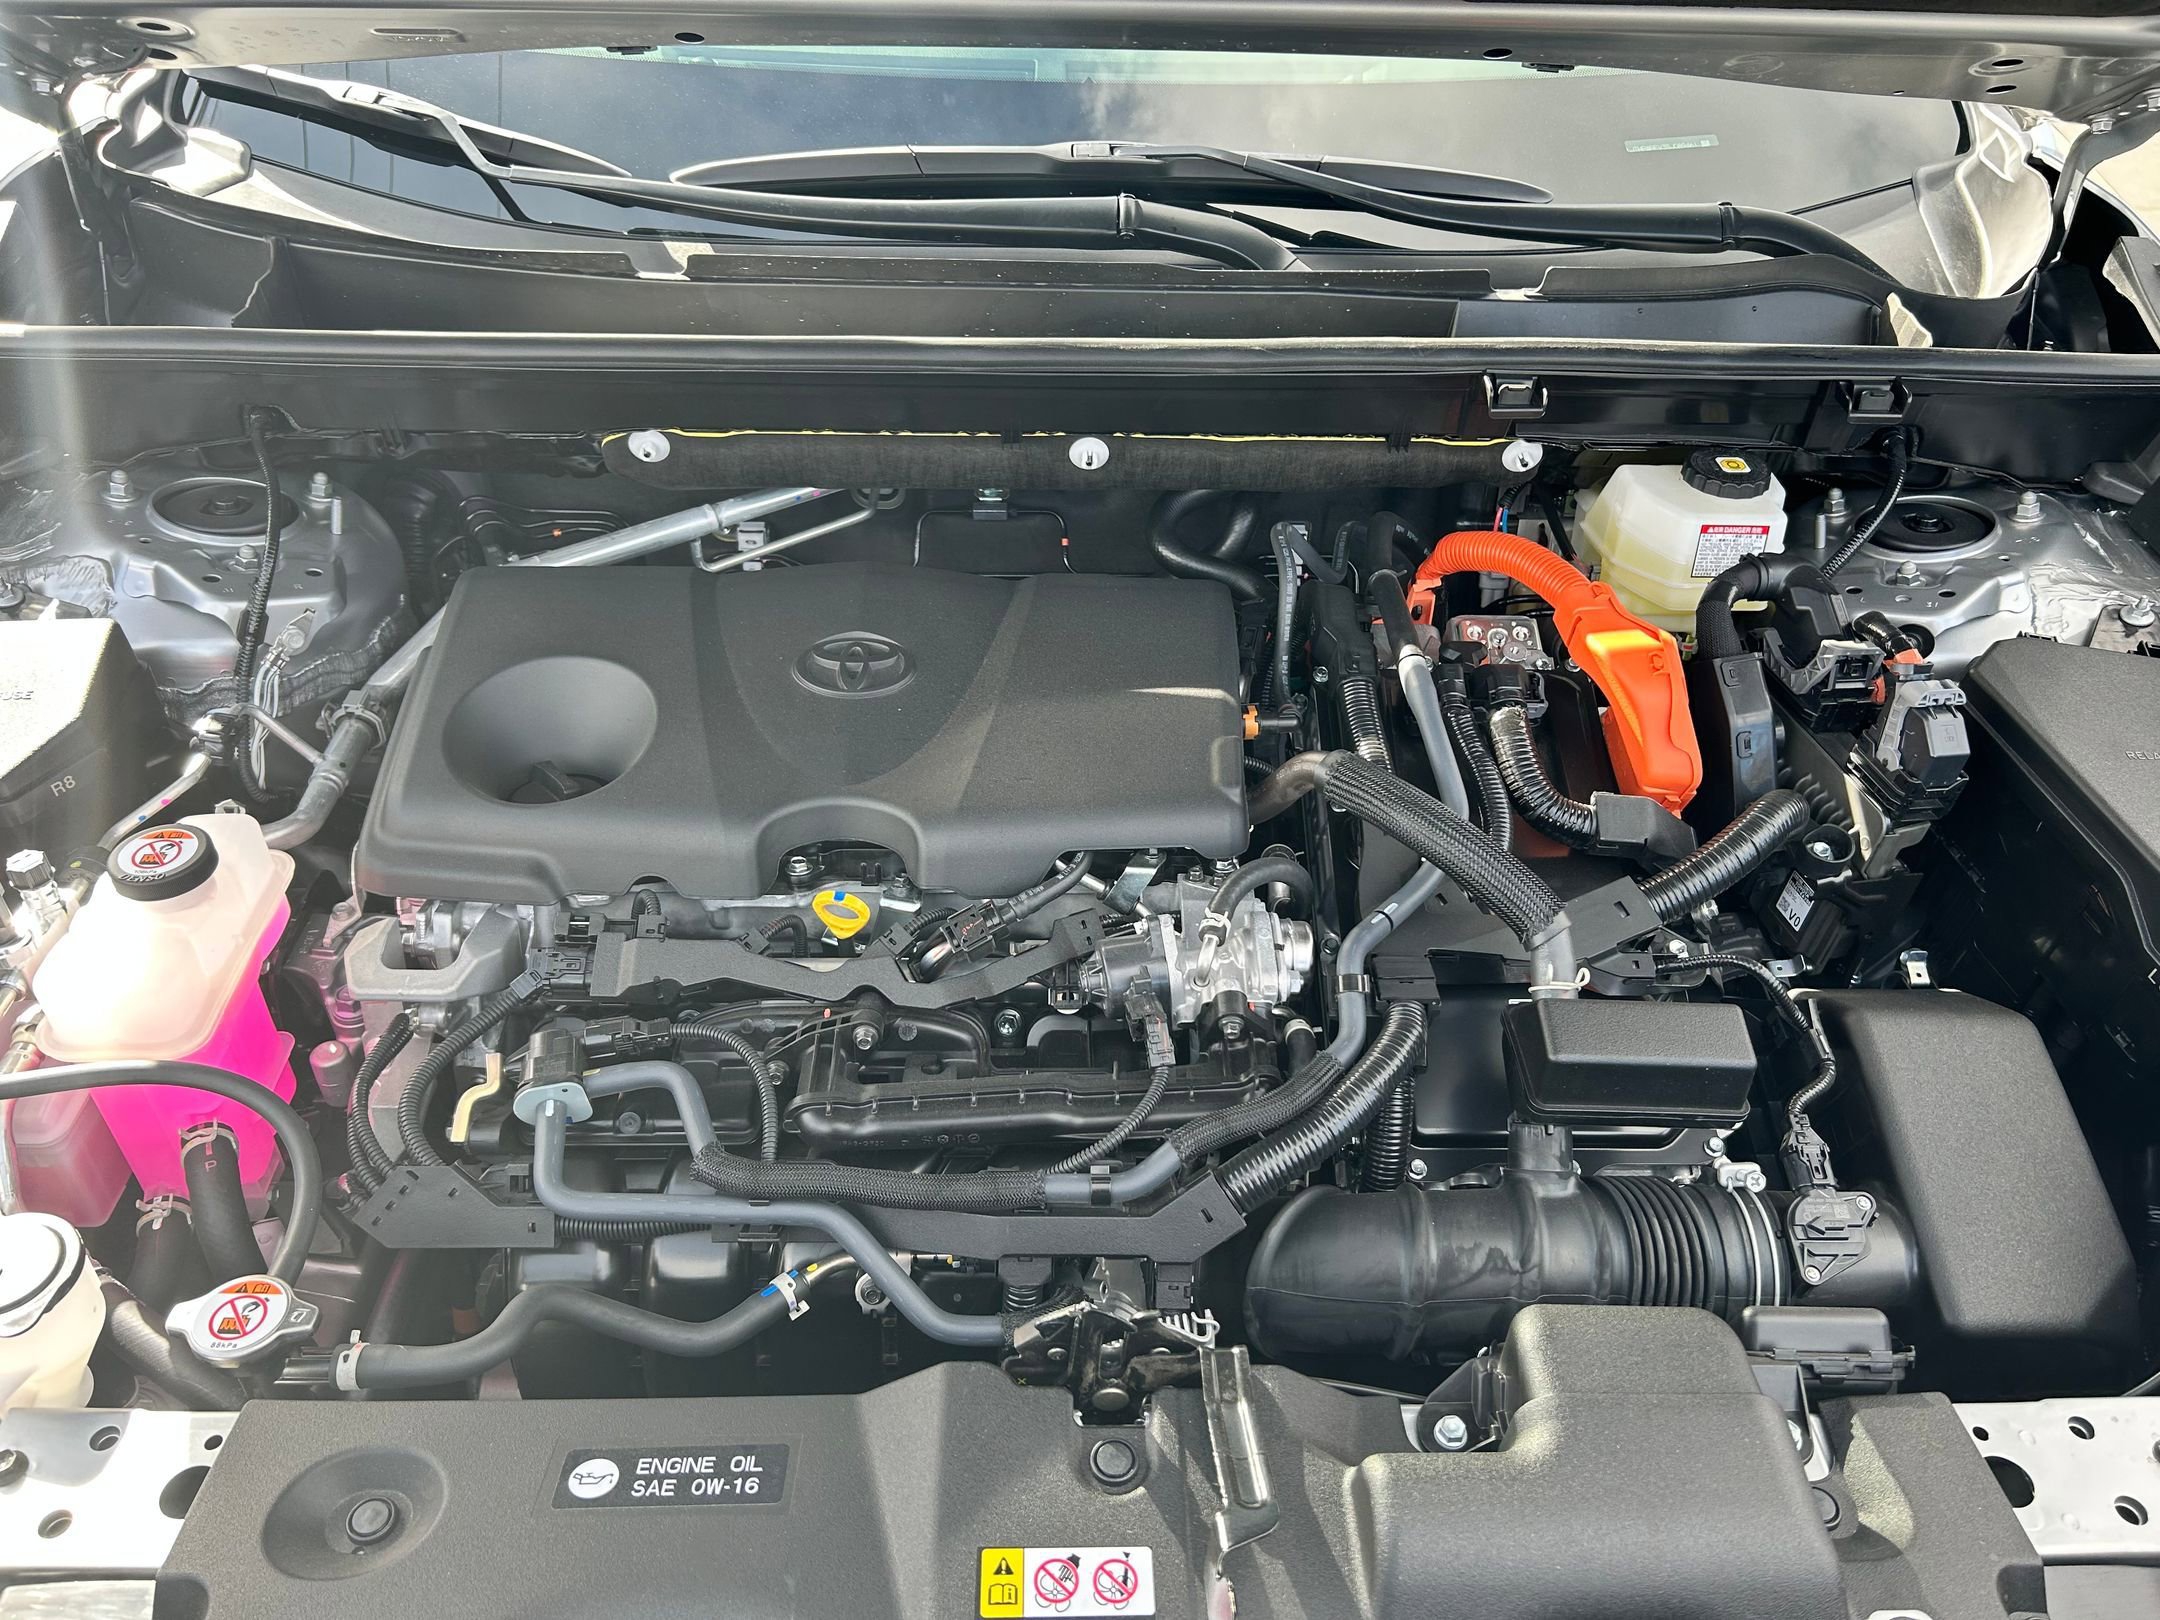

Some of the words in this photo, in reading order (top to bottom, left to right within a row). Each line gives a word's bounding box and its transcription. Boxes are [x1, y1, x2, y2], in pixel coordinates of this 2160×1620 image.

[50, 775, 77, 797] R8
[118, 873, 166, 883] DENSO
[204, 1160, 217, 1173] P
[635, 1456, 717, 1475] ENGINE
[730, 1455, 764, 1473] OIL
[630, 1479, 677, 1497] SAE
